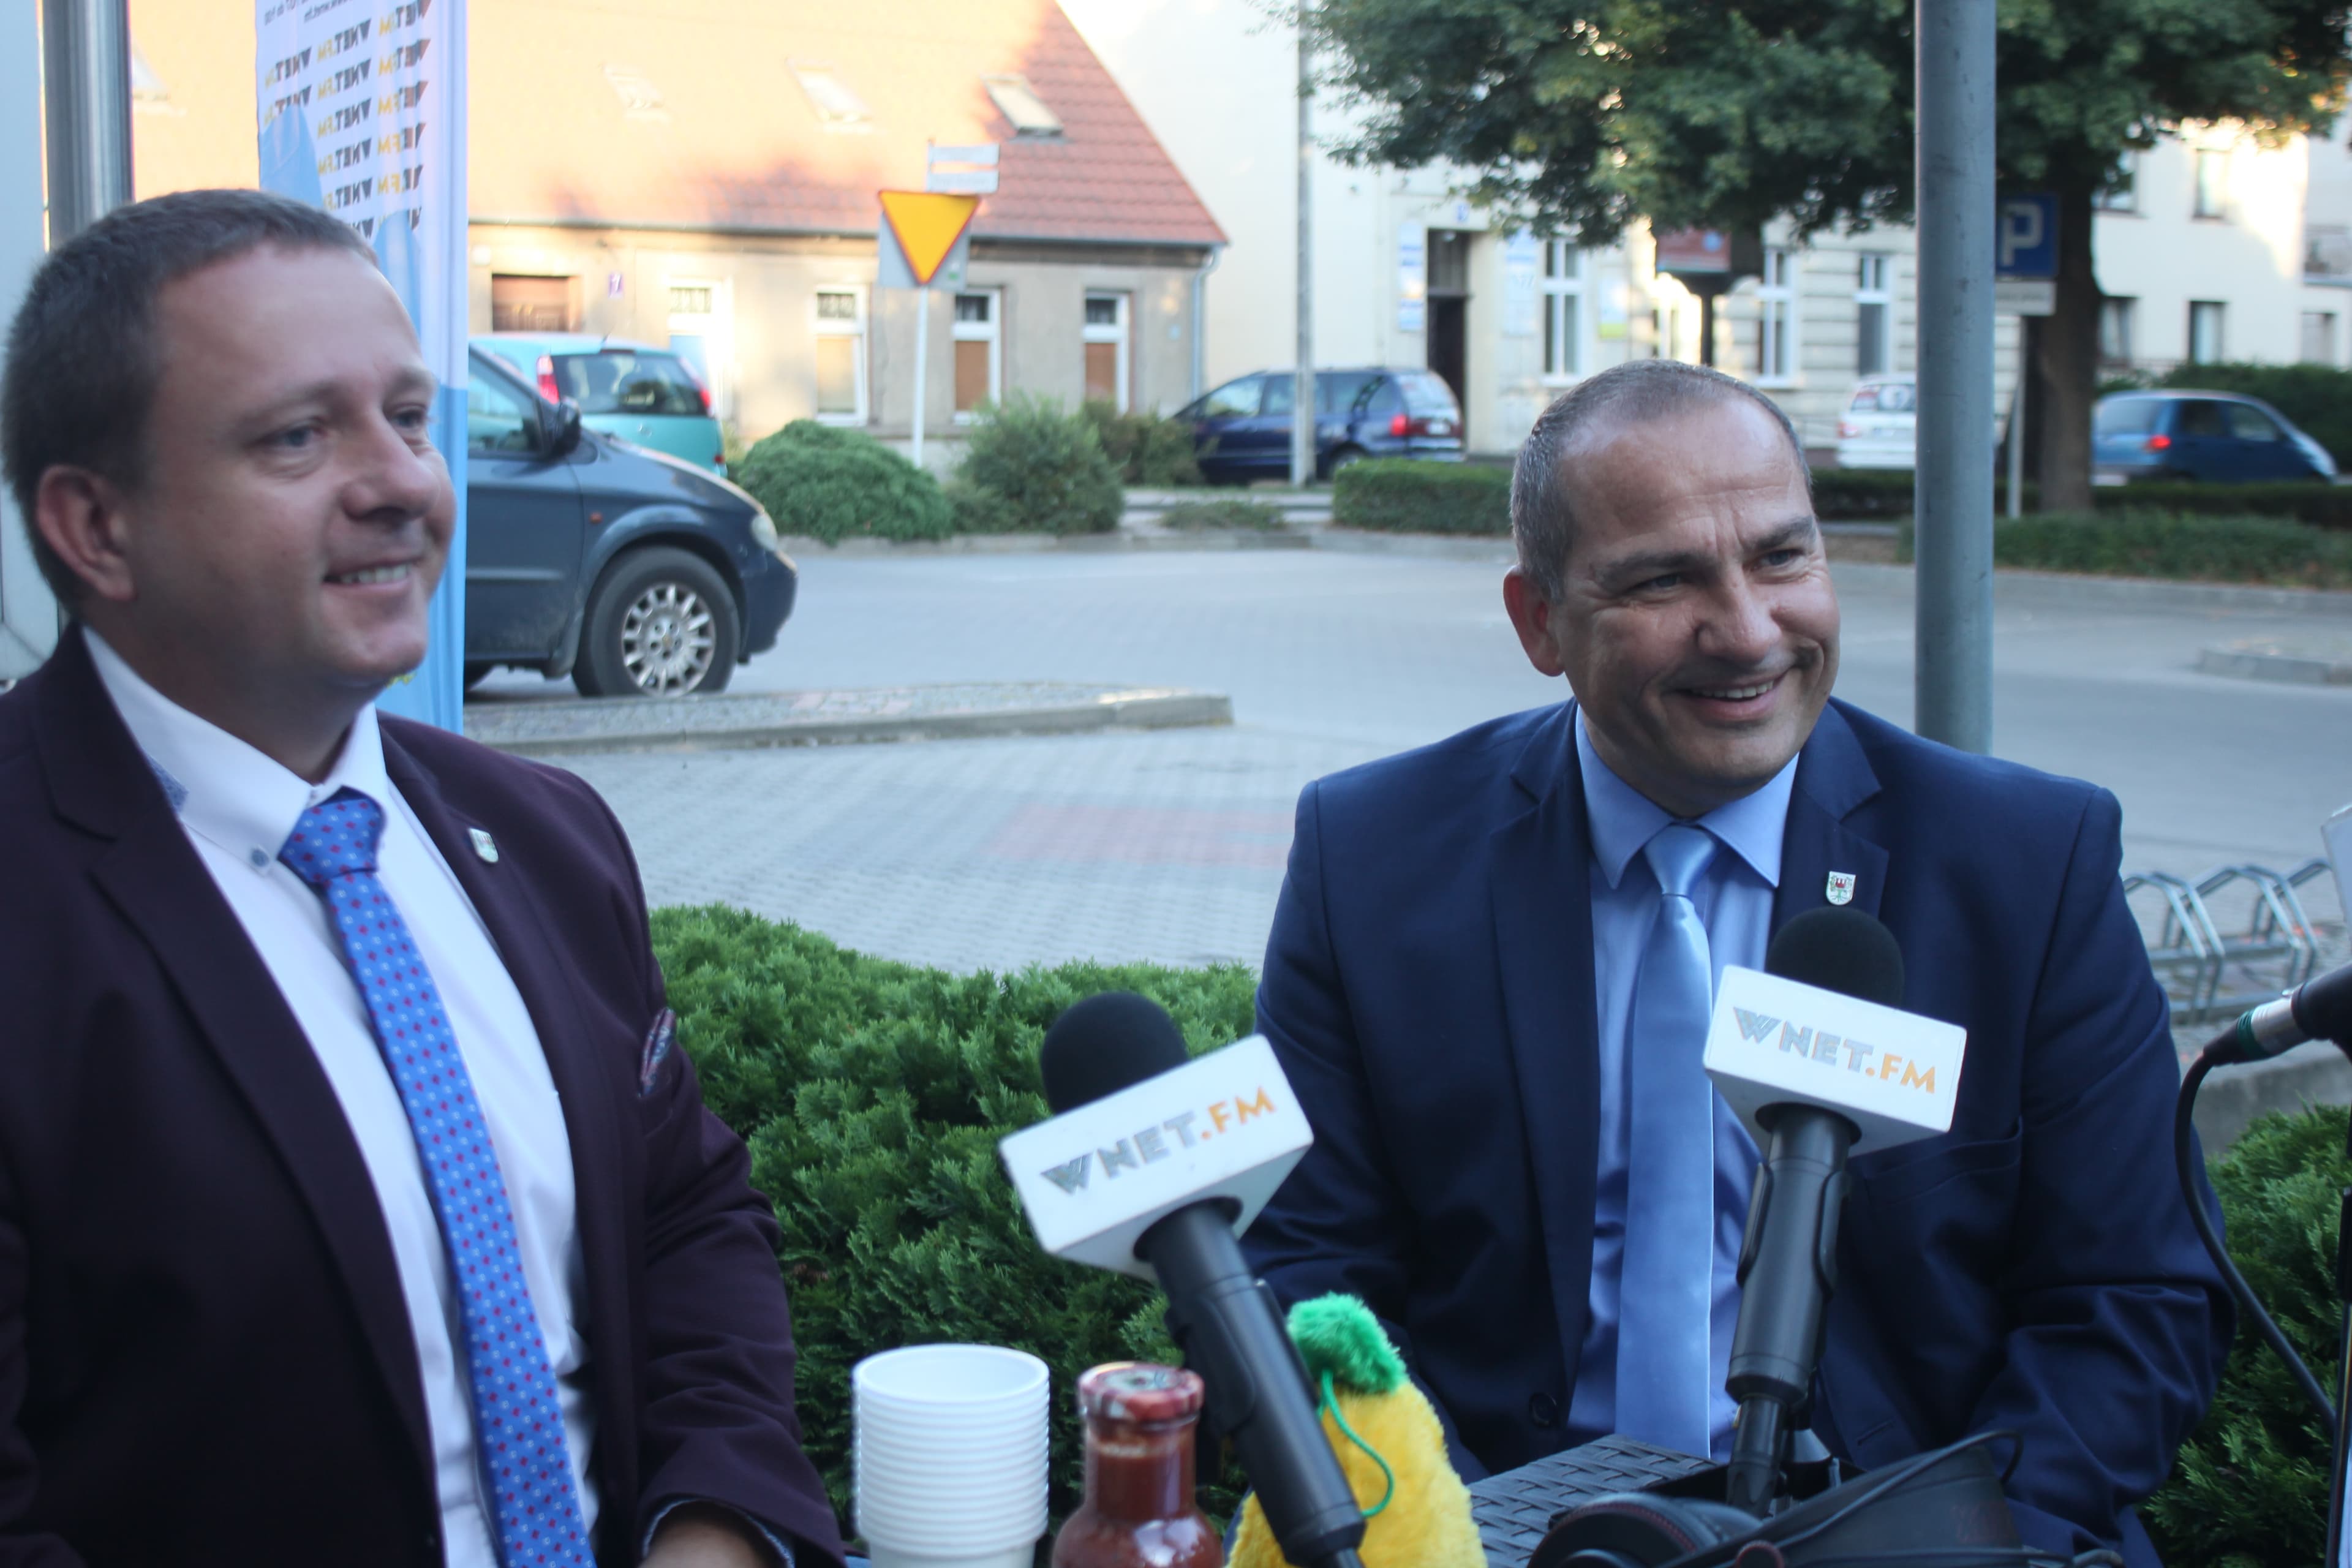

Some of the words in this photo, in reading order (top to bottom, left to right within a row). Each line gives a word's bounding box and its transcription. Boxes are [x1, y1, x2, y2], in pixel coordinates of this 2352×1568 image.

[2001, 203, 2044, 266] P
[1733, 1006, 1936, 1095] WNET.FM
[1039, 1085, 1276, 1196] WNET.FM
